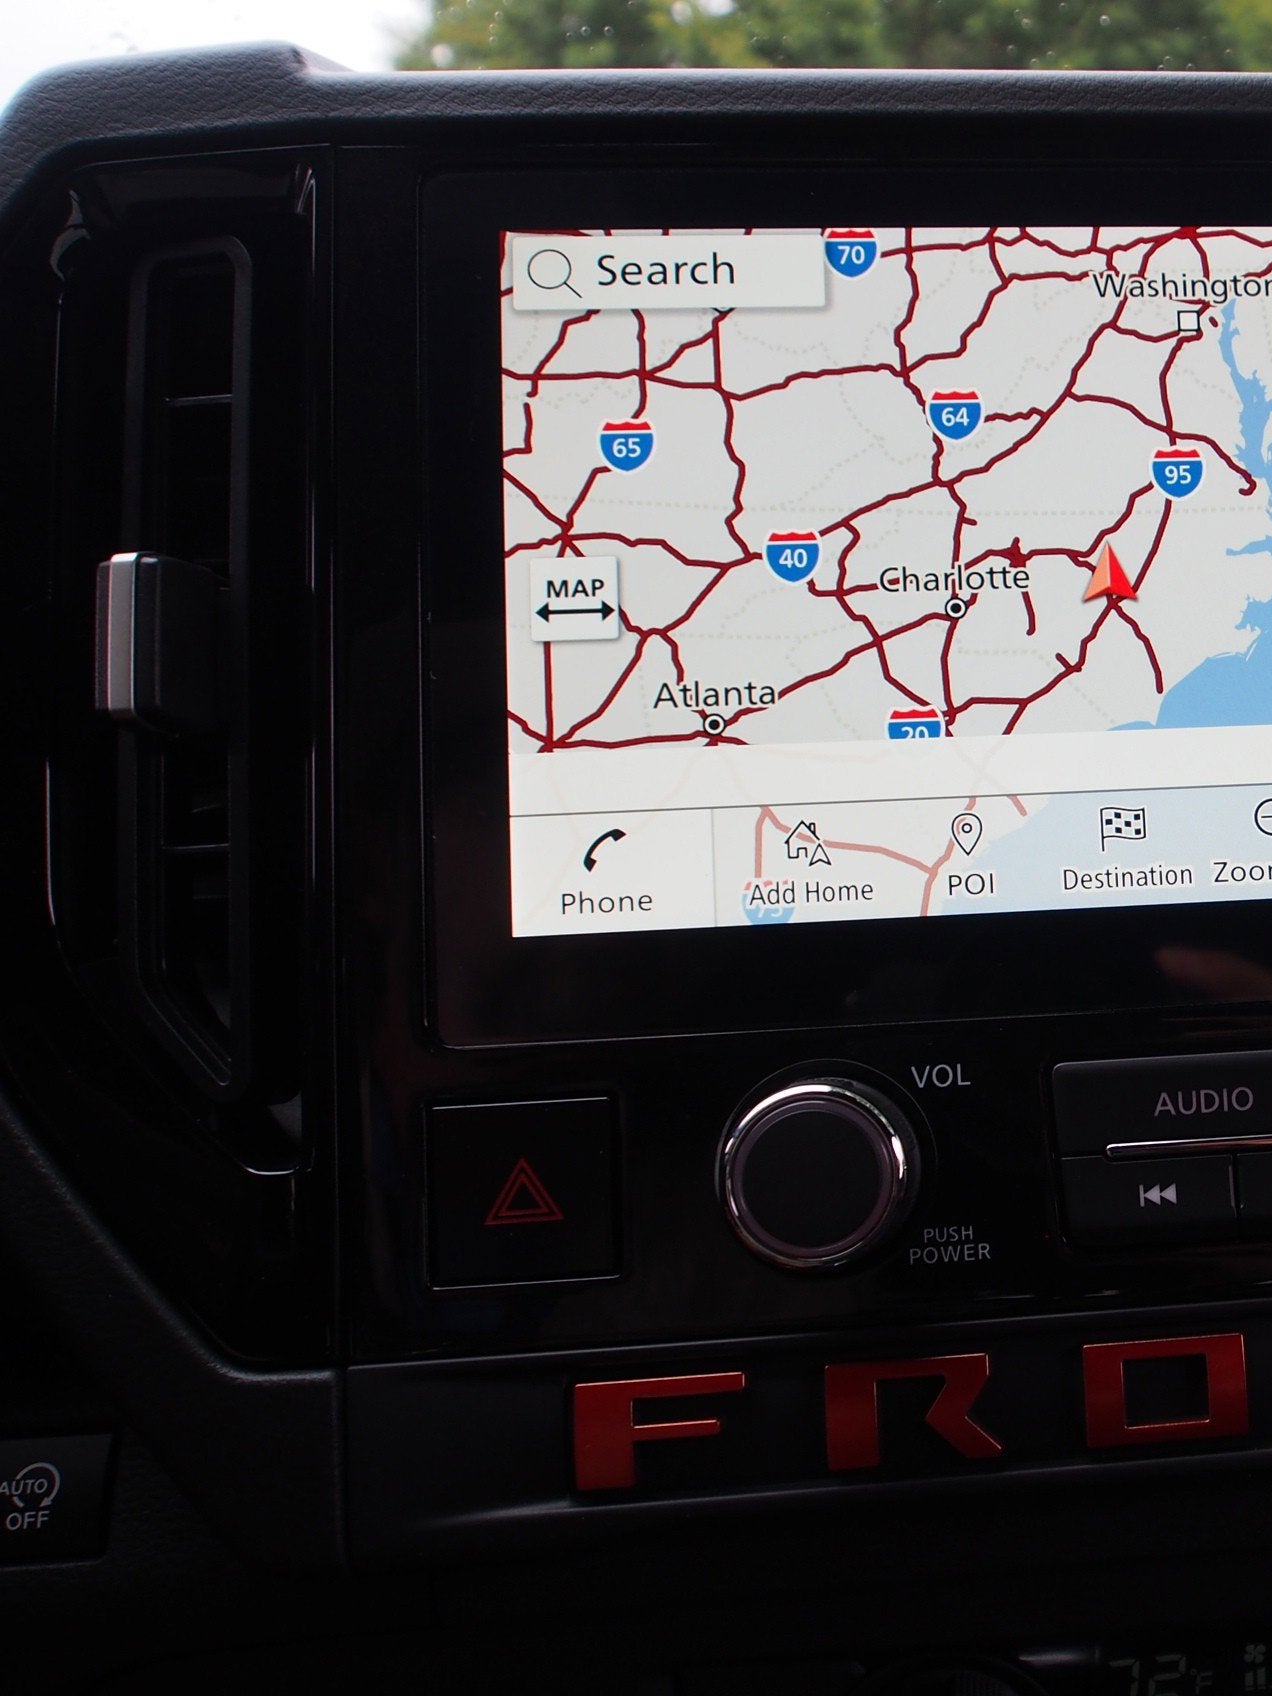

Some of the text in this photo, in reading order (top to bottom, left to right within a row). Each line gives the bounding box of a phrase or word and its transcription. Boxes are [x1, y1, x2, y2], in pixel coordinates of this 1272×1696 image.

[836, 243, 866, 265] 70
[597, 251, 735, 287] Search
[941, 406, 970, 427] 64
[612, 436, 641, 458] 65
[1164, 464, 1192, 485] 95
[778, 548, 808, 569] 40
[546, 578, 605, 600] MAP
[879, 564, 1031, 593] Charlotte
[653, 680, 777, 709] Atlanta
[901, 726, 929, 739] 20
[947, 872, 994, 896] POI
[1062, 865, 1194, 892] Destination
[560, 891, 653, 915] Phone
[749, 880, 874, 906] Add Home
[910, 1063, 971, 1089] VOL
[1153, 1086, 1255, 1118] AUDIO
[923, 1225, 975, 1244] PUSH
[909, 1242, 991, 1265] POWER
[0, 1478, 49, 1496] AUTO
[5, 1510, 51, 1531] OFF
